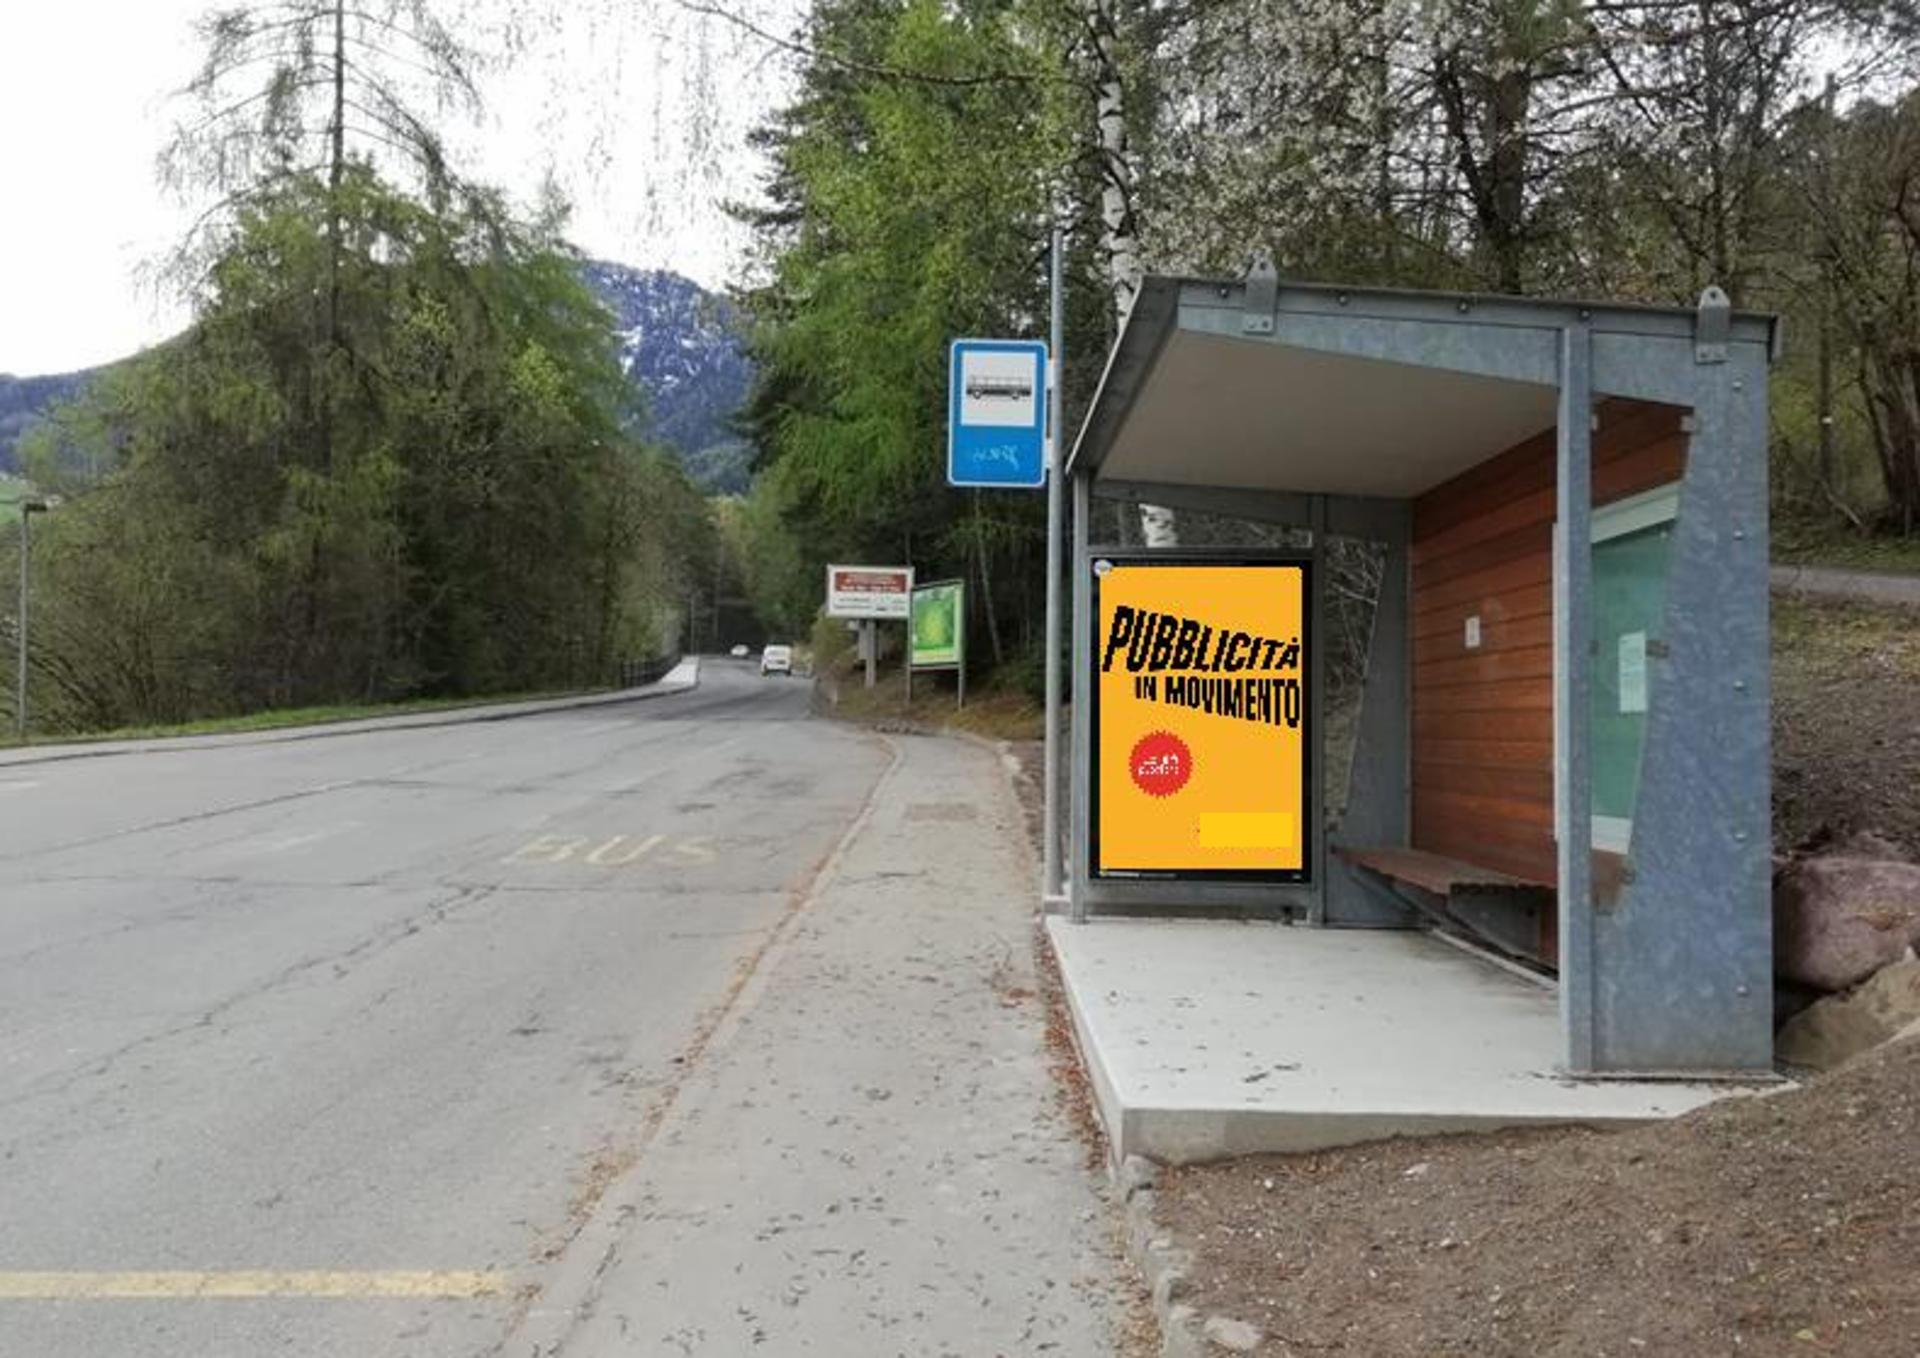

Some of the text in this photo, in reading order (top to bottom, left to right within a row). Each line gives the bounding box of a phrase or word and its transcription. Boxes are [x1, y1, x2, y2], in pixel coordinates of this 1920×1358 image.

[1135, 676, 1300, 728] IN MOVIMENTO
[503, 834, 716, 865] BUS
